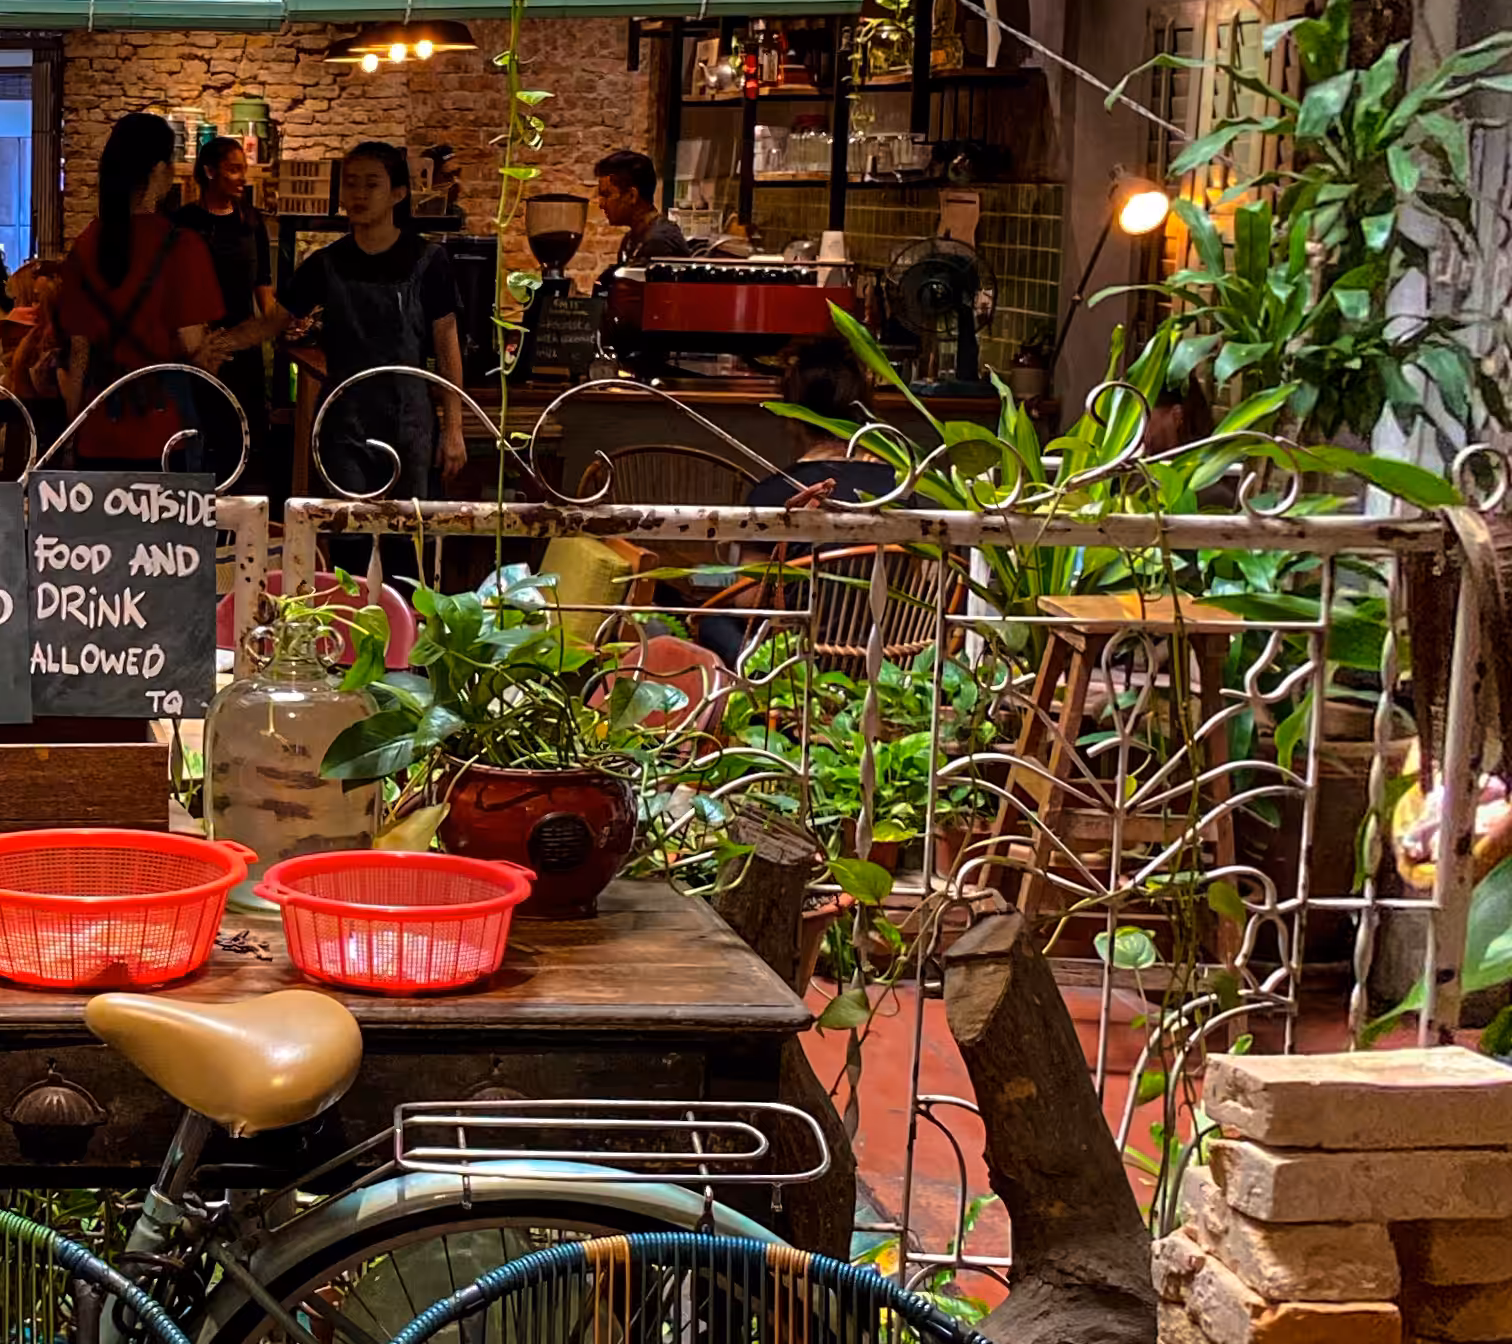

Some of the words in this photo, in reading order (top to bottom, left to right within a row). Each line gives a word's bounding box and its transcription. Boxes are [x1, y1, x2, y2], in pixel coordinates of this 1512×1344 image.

[38, 480, 94, 514] NO
[34, 534, 112, 574] FOOD
[128, 544, 201, 577] AND
[30, 643, 166, 678] ALLOWED
[145, 690, 183, 715] TQ
